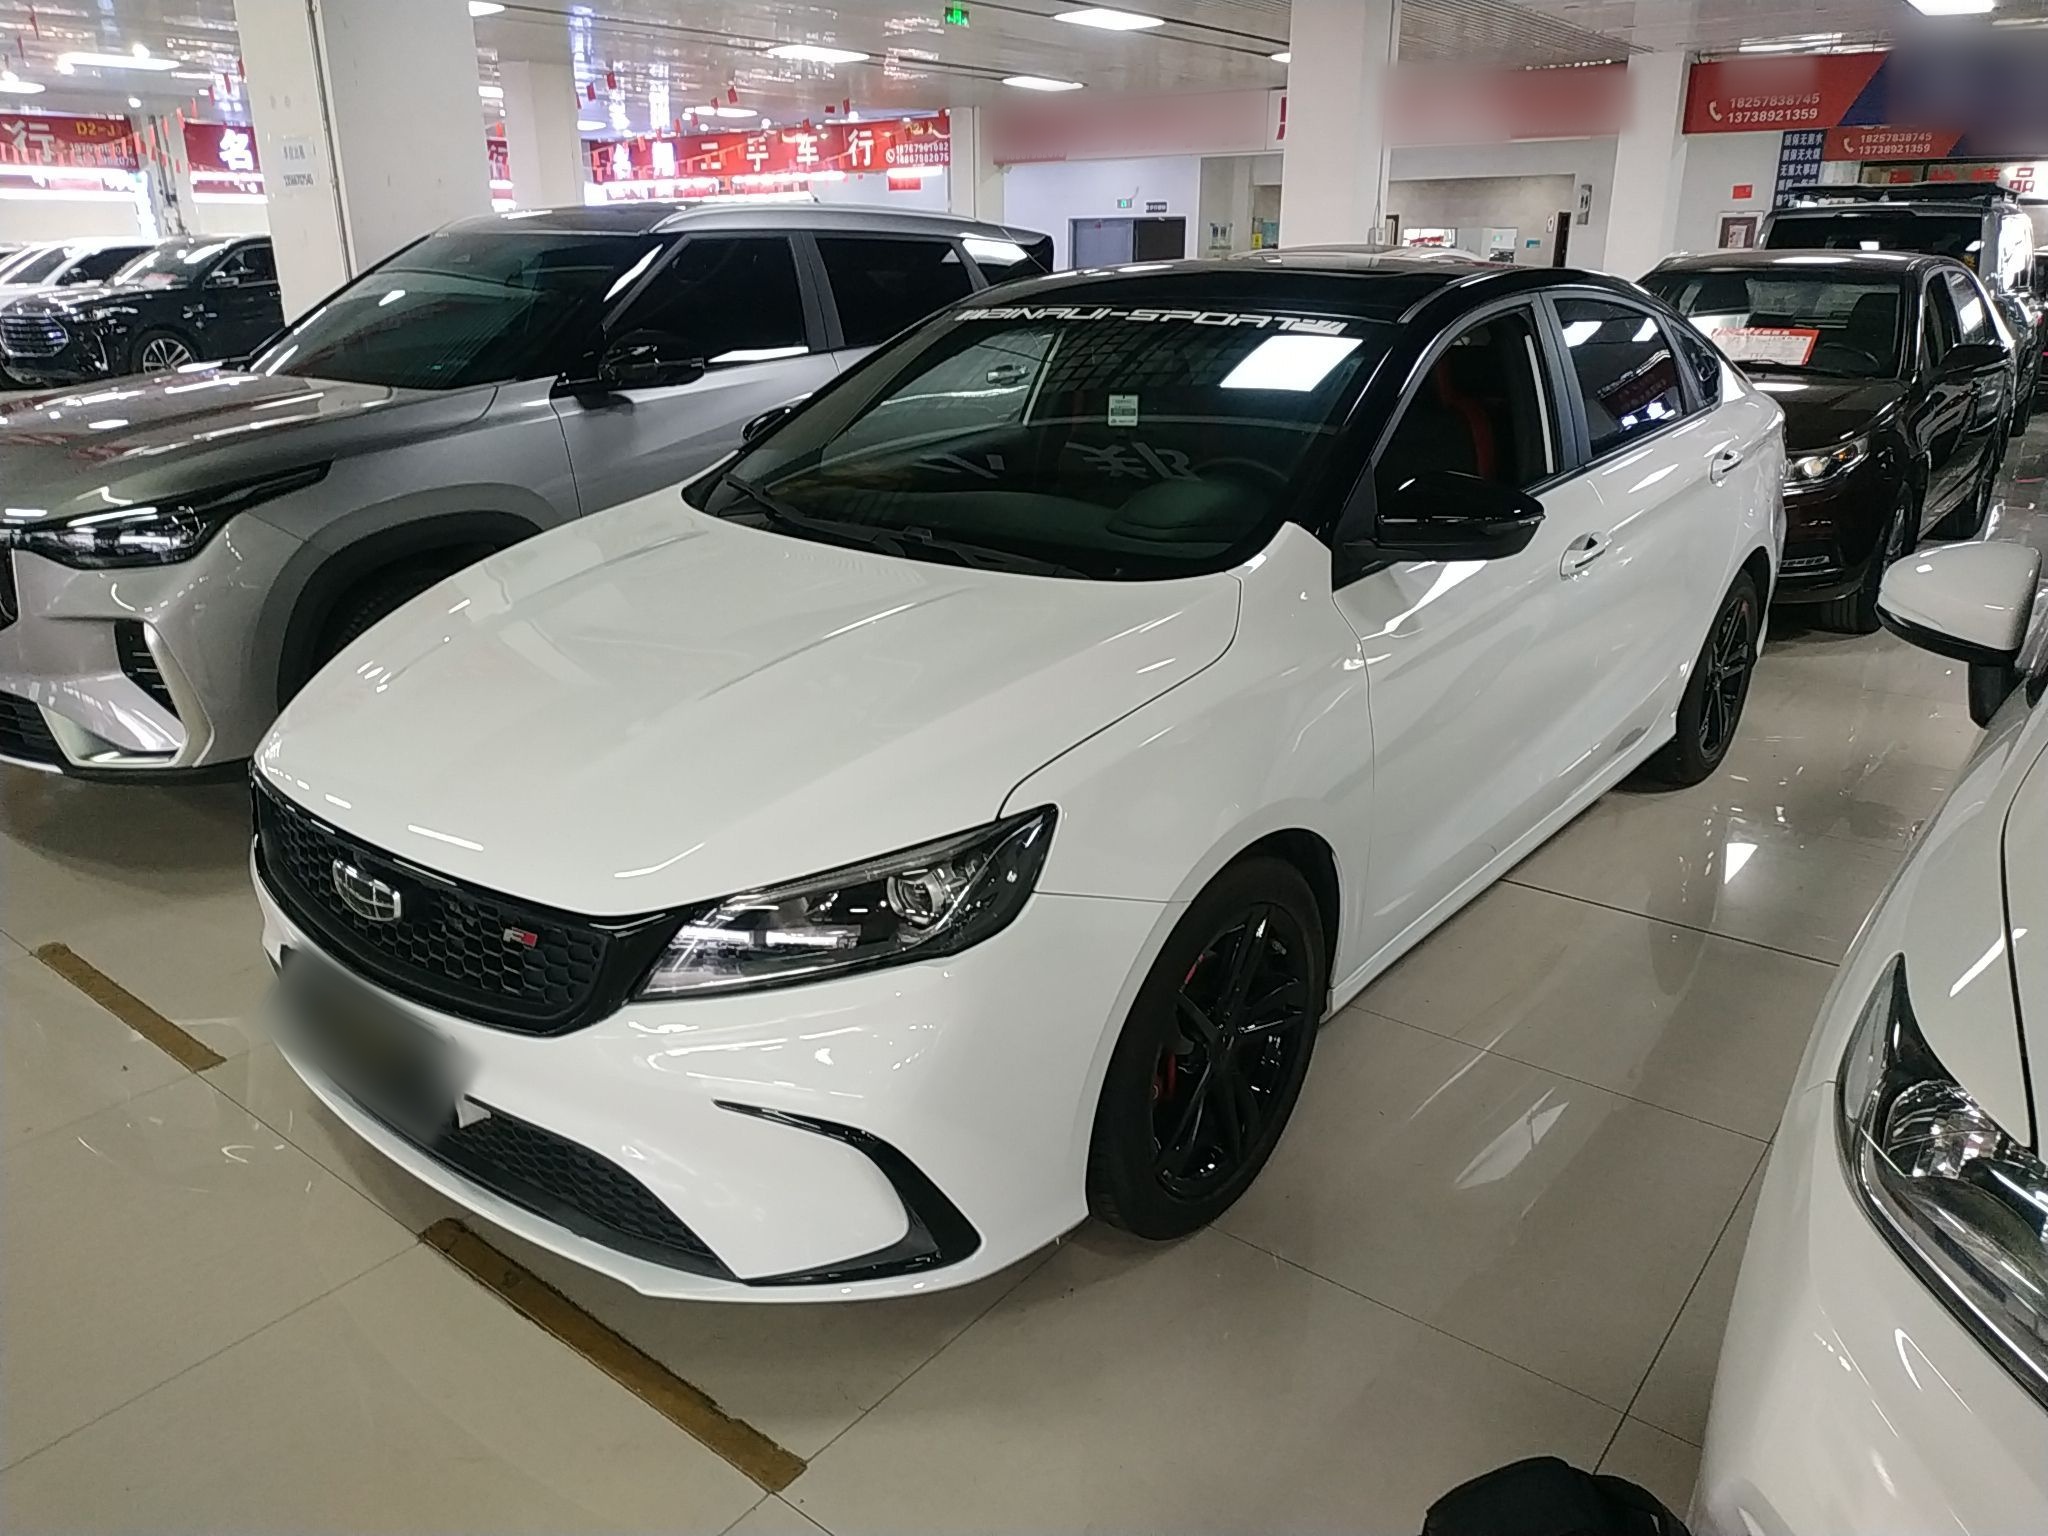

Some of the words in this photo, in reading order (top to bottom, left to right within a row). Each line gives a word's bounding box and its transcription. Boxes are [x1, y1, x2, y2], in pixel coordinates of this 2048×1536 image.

[1729, 92, 1820, 109] 18257838745
[1726, 107, 1819, 124] 13738921359
[1860, 131, 1932, 144] 18257838745
[1858, 143, 1931, 155] 13738921359
